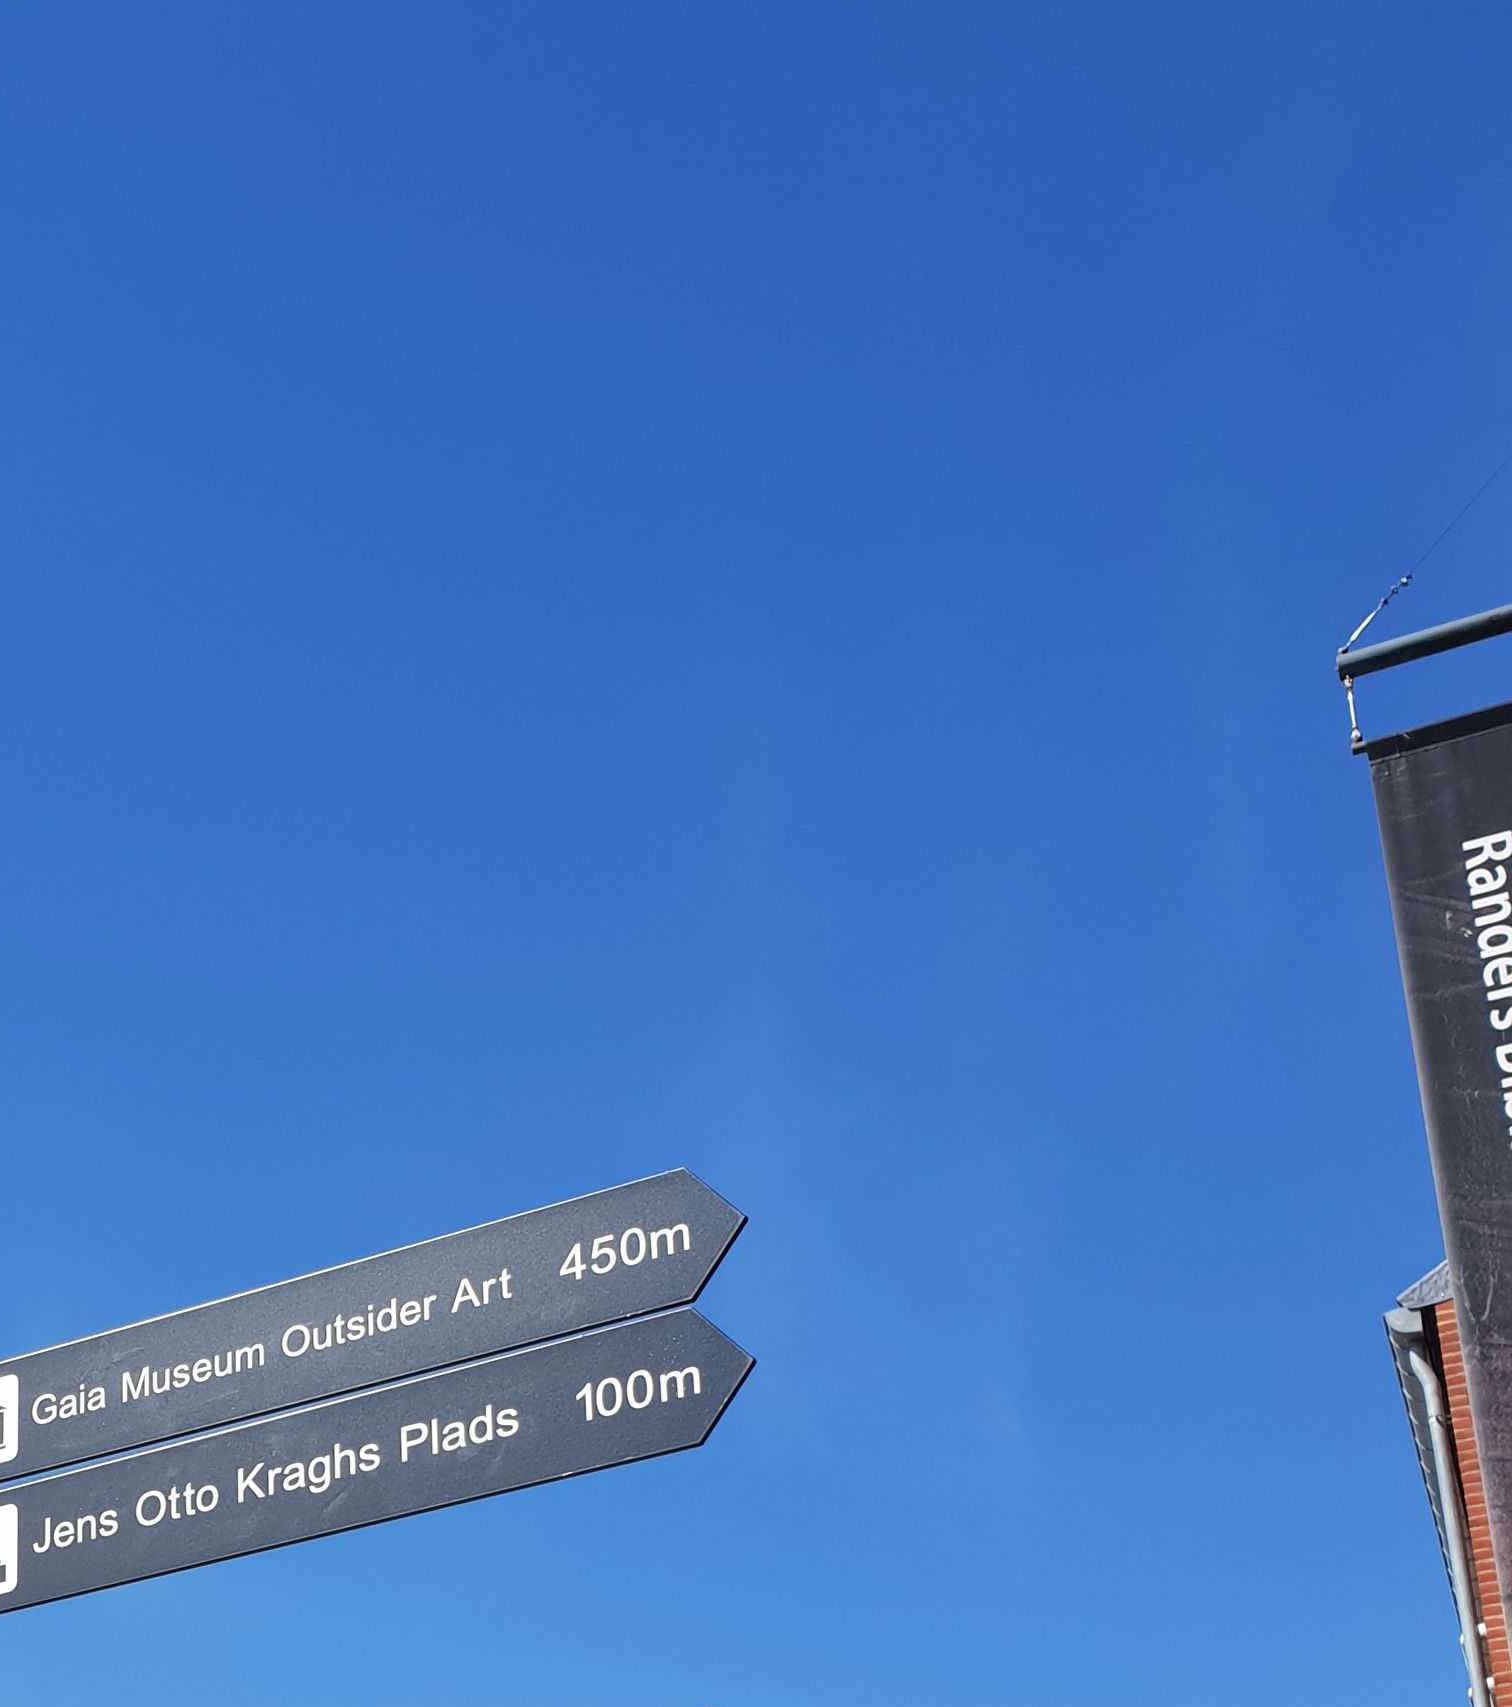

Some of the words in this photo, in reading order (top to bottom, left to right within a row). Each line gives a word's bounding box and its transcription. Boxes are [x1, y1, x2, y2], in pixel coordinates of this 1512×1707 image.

[32, 1387, 105, 1424] Gaia
[123, 1344, 264, 1402] Museum
[282, 1295, 436, 1357] Outsider
[452, 1269, 512, 1313] Art
[560, 1224, 690, 1279] 450m
[33, 1510, 118, 1553] Jens
[136, 1483, 218, 1526] Otto
[238, 1444, 380, 1502] Kraghs
[401, 1405, 519, 1462] Plads
[576, 1367, 700, 1420] 100m
